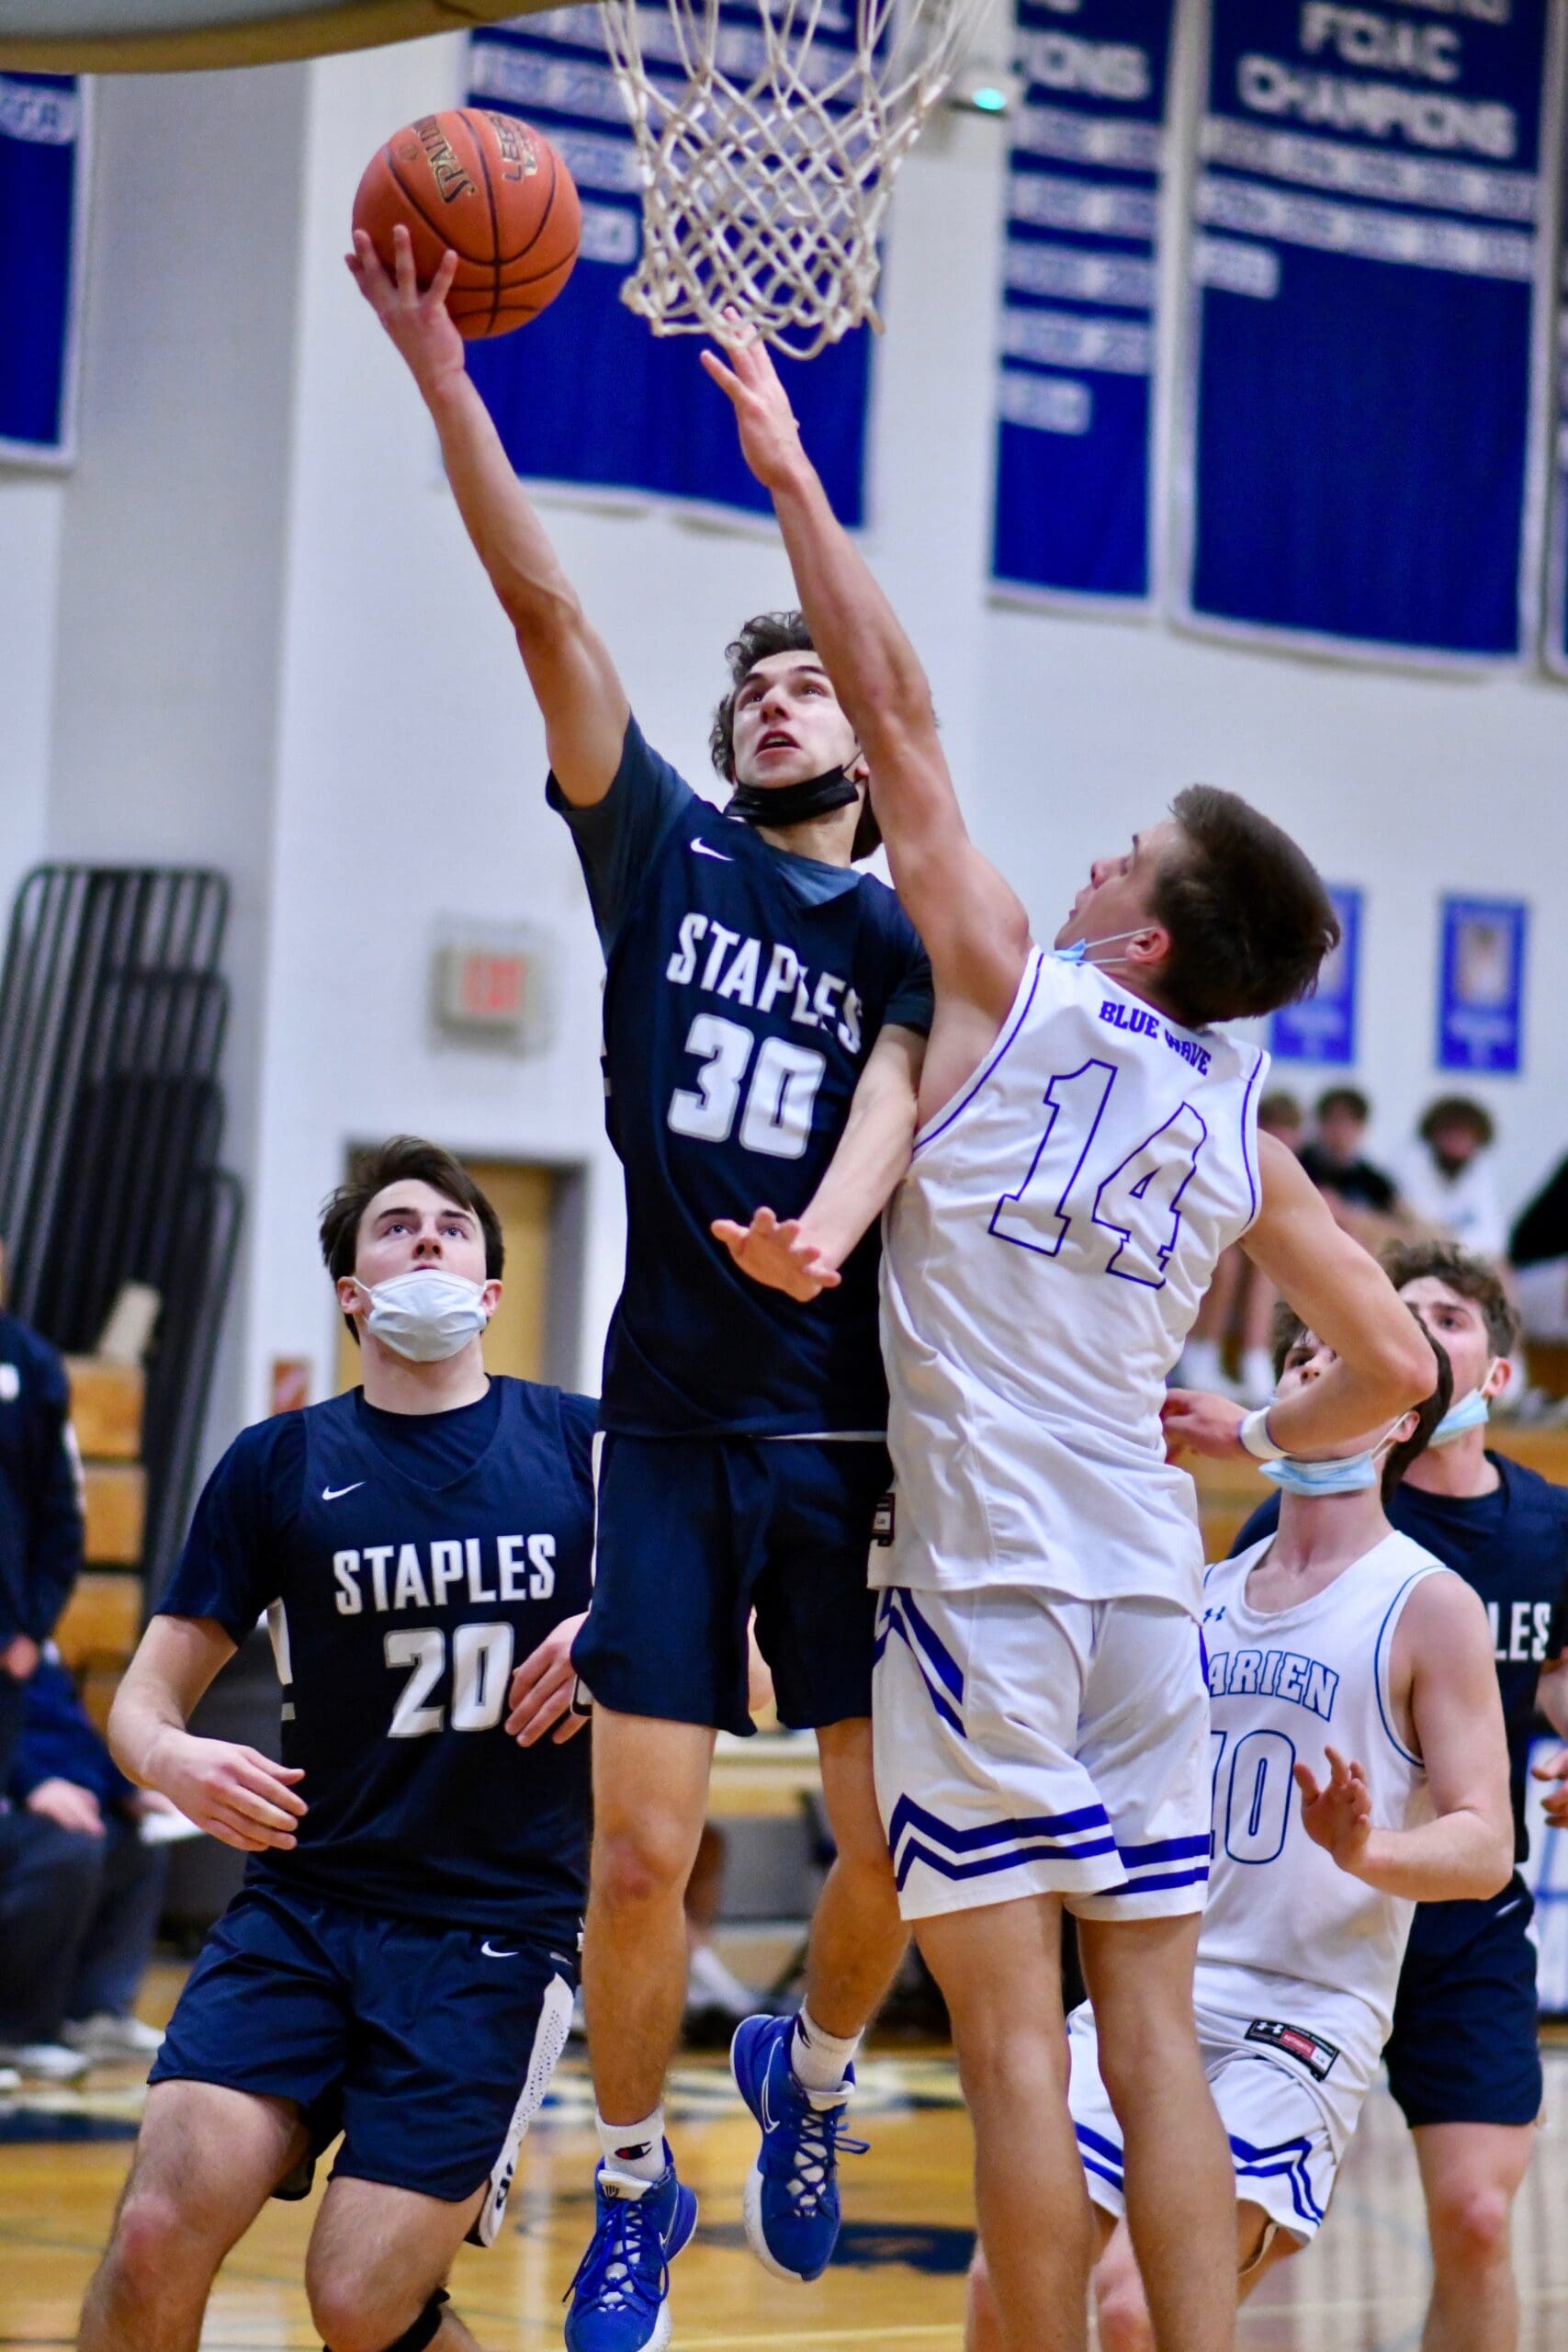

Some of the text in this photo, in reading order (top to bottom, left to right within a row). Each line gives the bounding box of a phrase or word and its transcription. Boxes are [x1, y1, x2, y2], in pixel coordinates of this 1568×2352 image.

[666, 912, 863, 1055] STAPLES
[1099, 1001, 1212, 1076] BLUE WAVE
[667, 1012, 827, 1159] 30
[988, 1058, 1208, 1290] 14
[333, 1533, 556, 1615] STAPLES
[383, 1622, 514, 1738] 20
[1209, 1649, 1339, 1722] ARIEN
